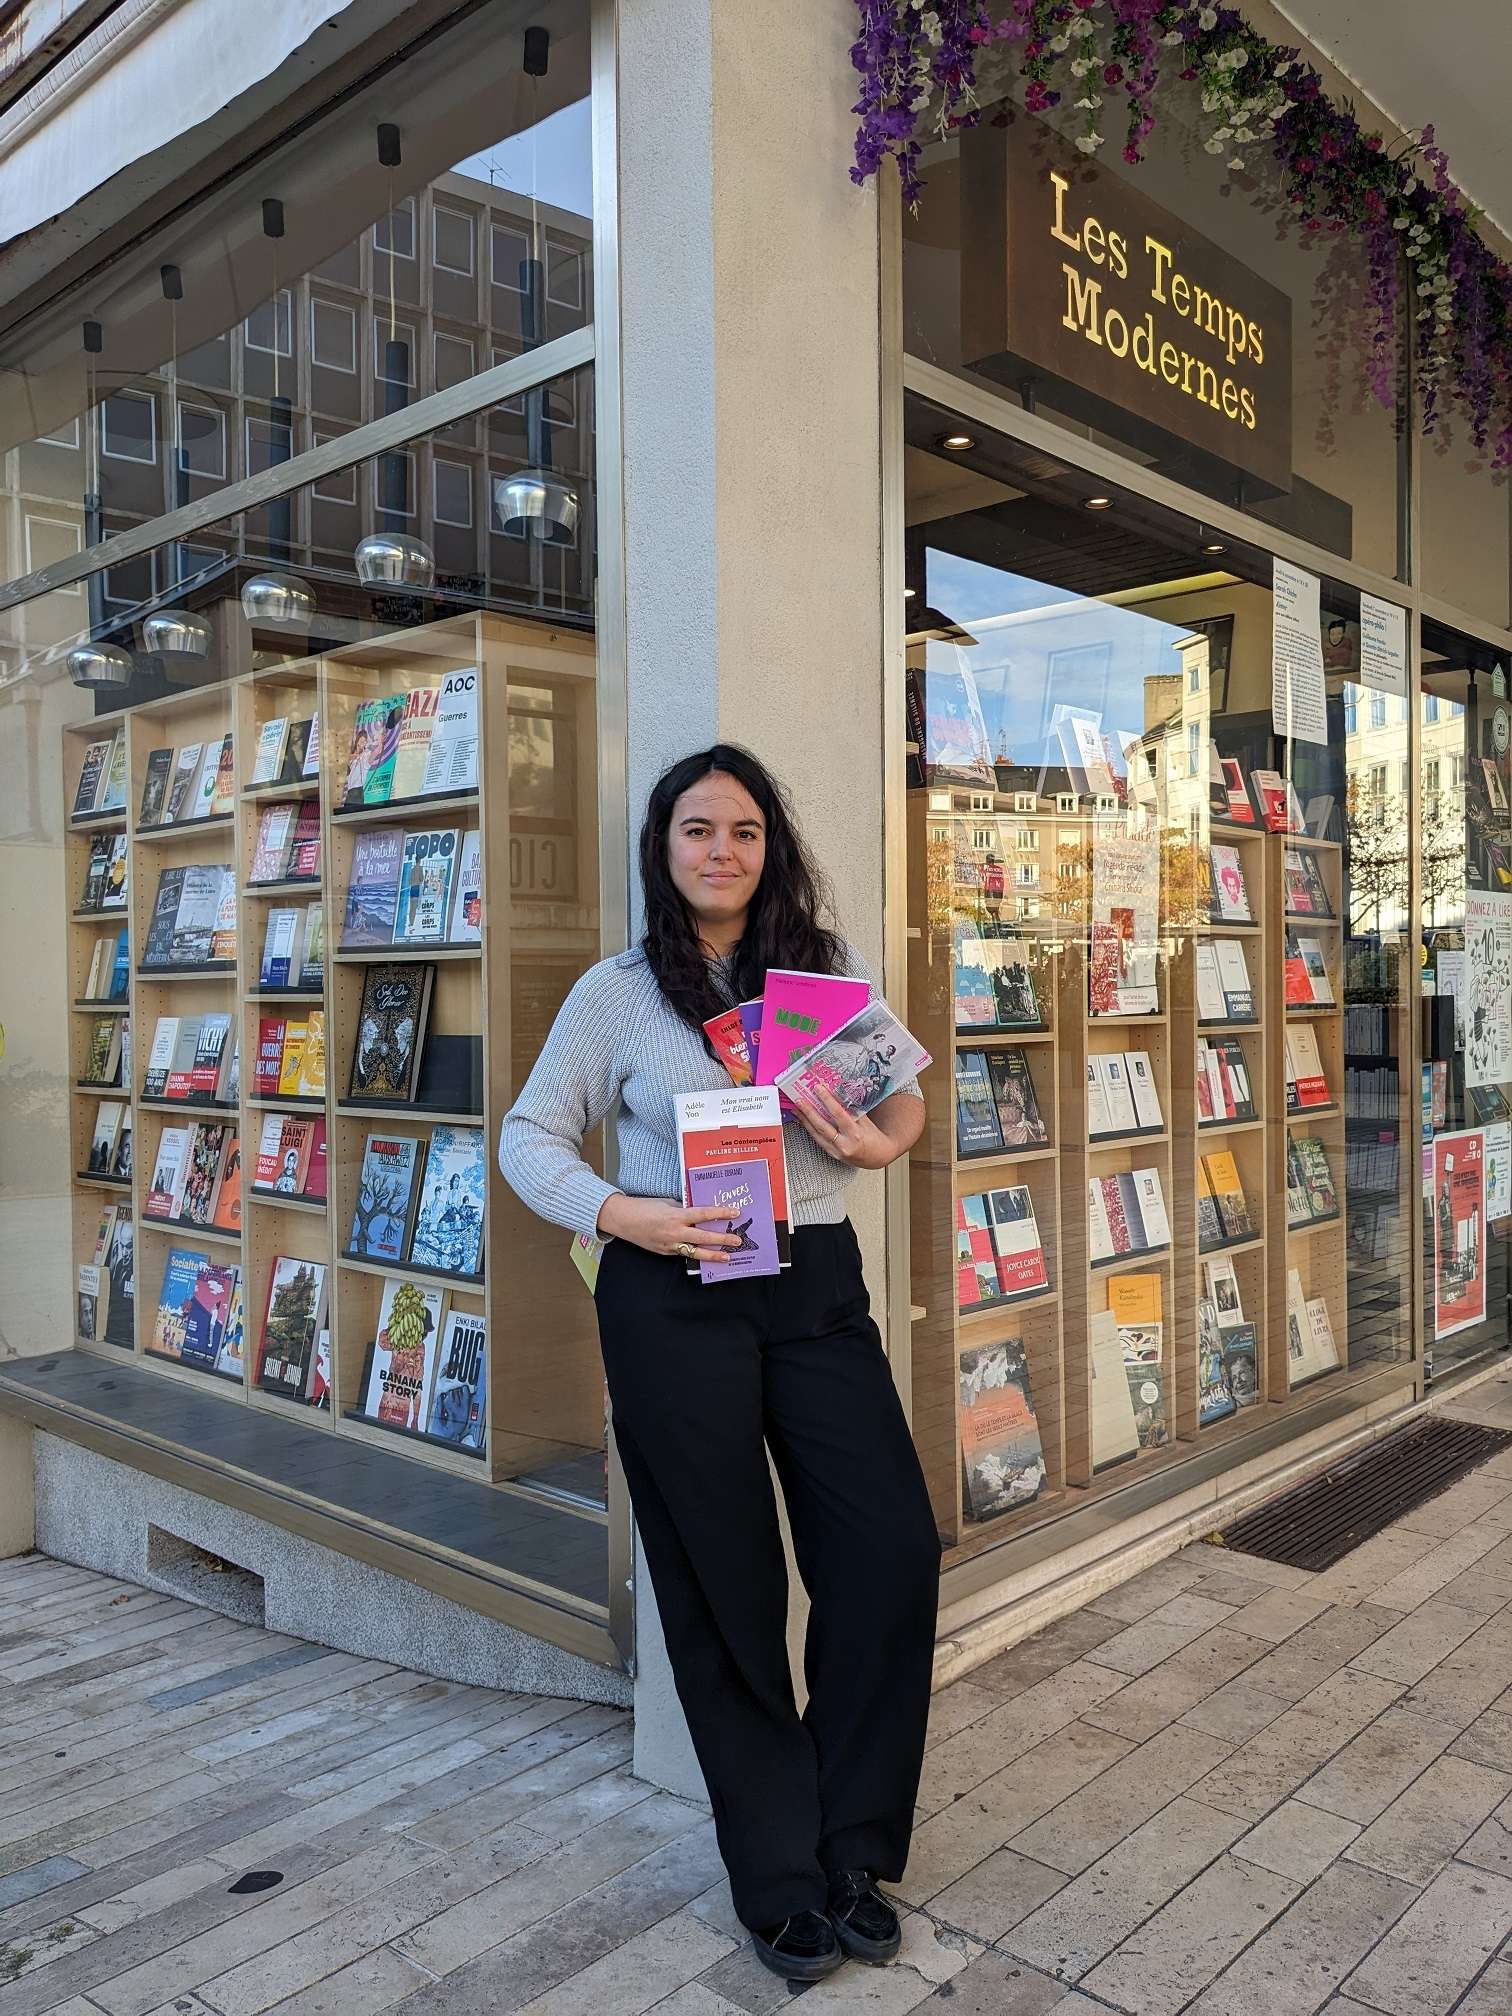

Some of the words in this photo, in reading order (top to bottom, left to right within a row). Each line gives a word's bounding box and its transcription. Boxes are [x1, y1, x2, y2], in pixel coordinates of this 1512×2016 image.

[1051, 170, 1128, 279] Les
[1145, 235, 1264, 365] Temps
[1062, 263, 1256, 430] Modernes
[444, 675, 476, 695] AOC
[438, 711, 468, 723] Guerres
[1466, 901, 1490, 916] DONNEZ
[1481, 928, 1494, 964] 10
[1227, 994, 1252, 1002] EMMANUEL
[776, 1007, 822, 1036] MODE
[198, 1027, 227, 1051] VICHY
[684, 1102, 705, 1110] Adèle
[720, 1098, 737, 1106] Mon
[738, 1096, 754, 1104] vrai
[754, 1094, 770, 1102] nom
[721, 1106, 731, 1114] est
[732, 1102, 764, 1112] Elisabeth
[282, 1126, 307, 1138] SAINT
[280, 1136, 304, 1148] LUIGI
[734, 1137, 776, 1146] Contemplées
[705, 1148, 732, 1156] PAULINE
[733, 1146, 759, 1154] HILLIER
[259, 1157, 278, 1167] FOUCAU
[694, 1170, 724, 1182] EMMANUELLE
[724, 1168, 743, 1178] DURAND
[714, 1182, 750, 1207] L'ENVERS
[171, 1255, 199, 1272] Socialte
[1006, 1262, 1023, 1273] JOYCE
[1023, 1256, 1040, 1268] CAROL
[1018, 1270, 1034, 1280] OATES
[455, 1316, 470, 1328] ENKI
[447, 1326, 486, 1386] BUG
[380, 1370, 424, 1391] BANANA
[382, 1382, 418, 1400] STORY
